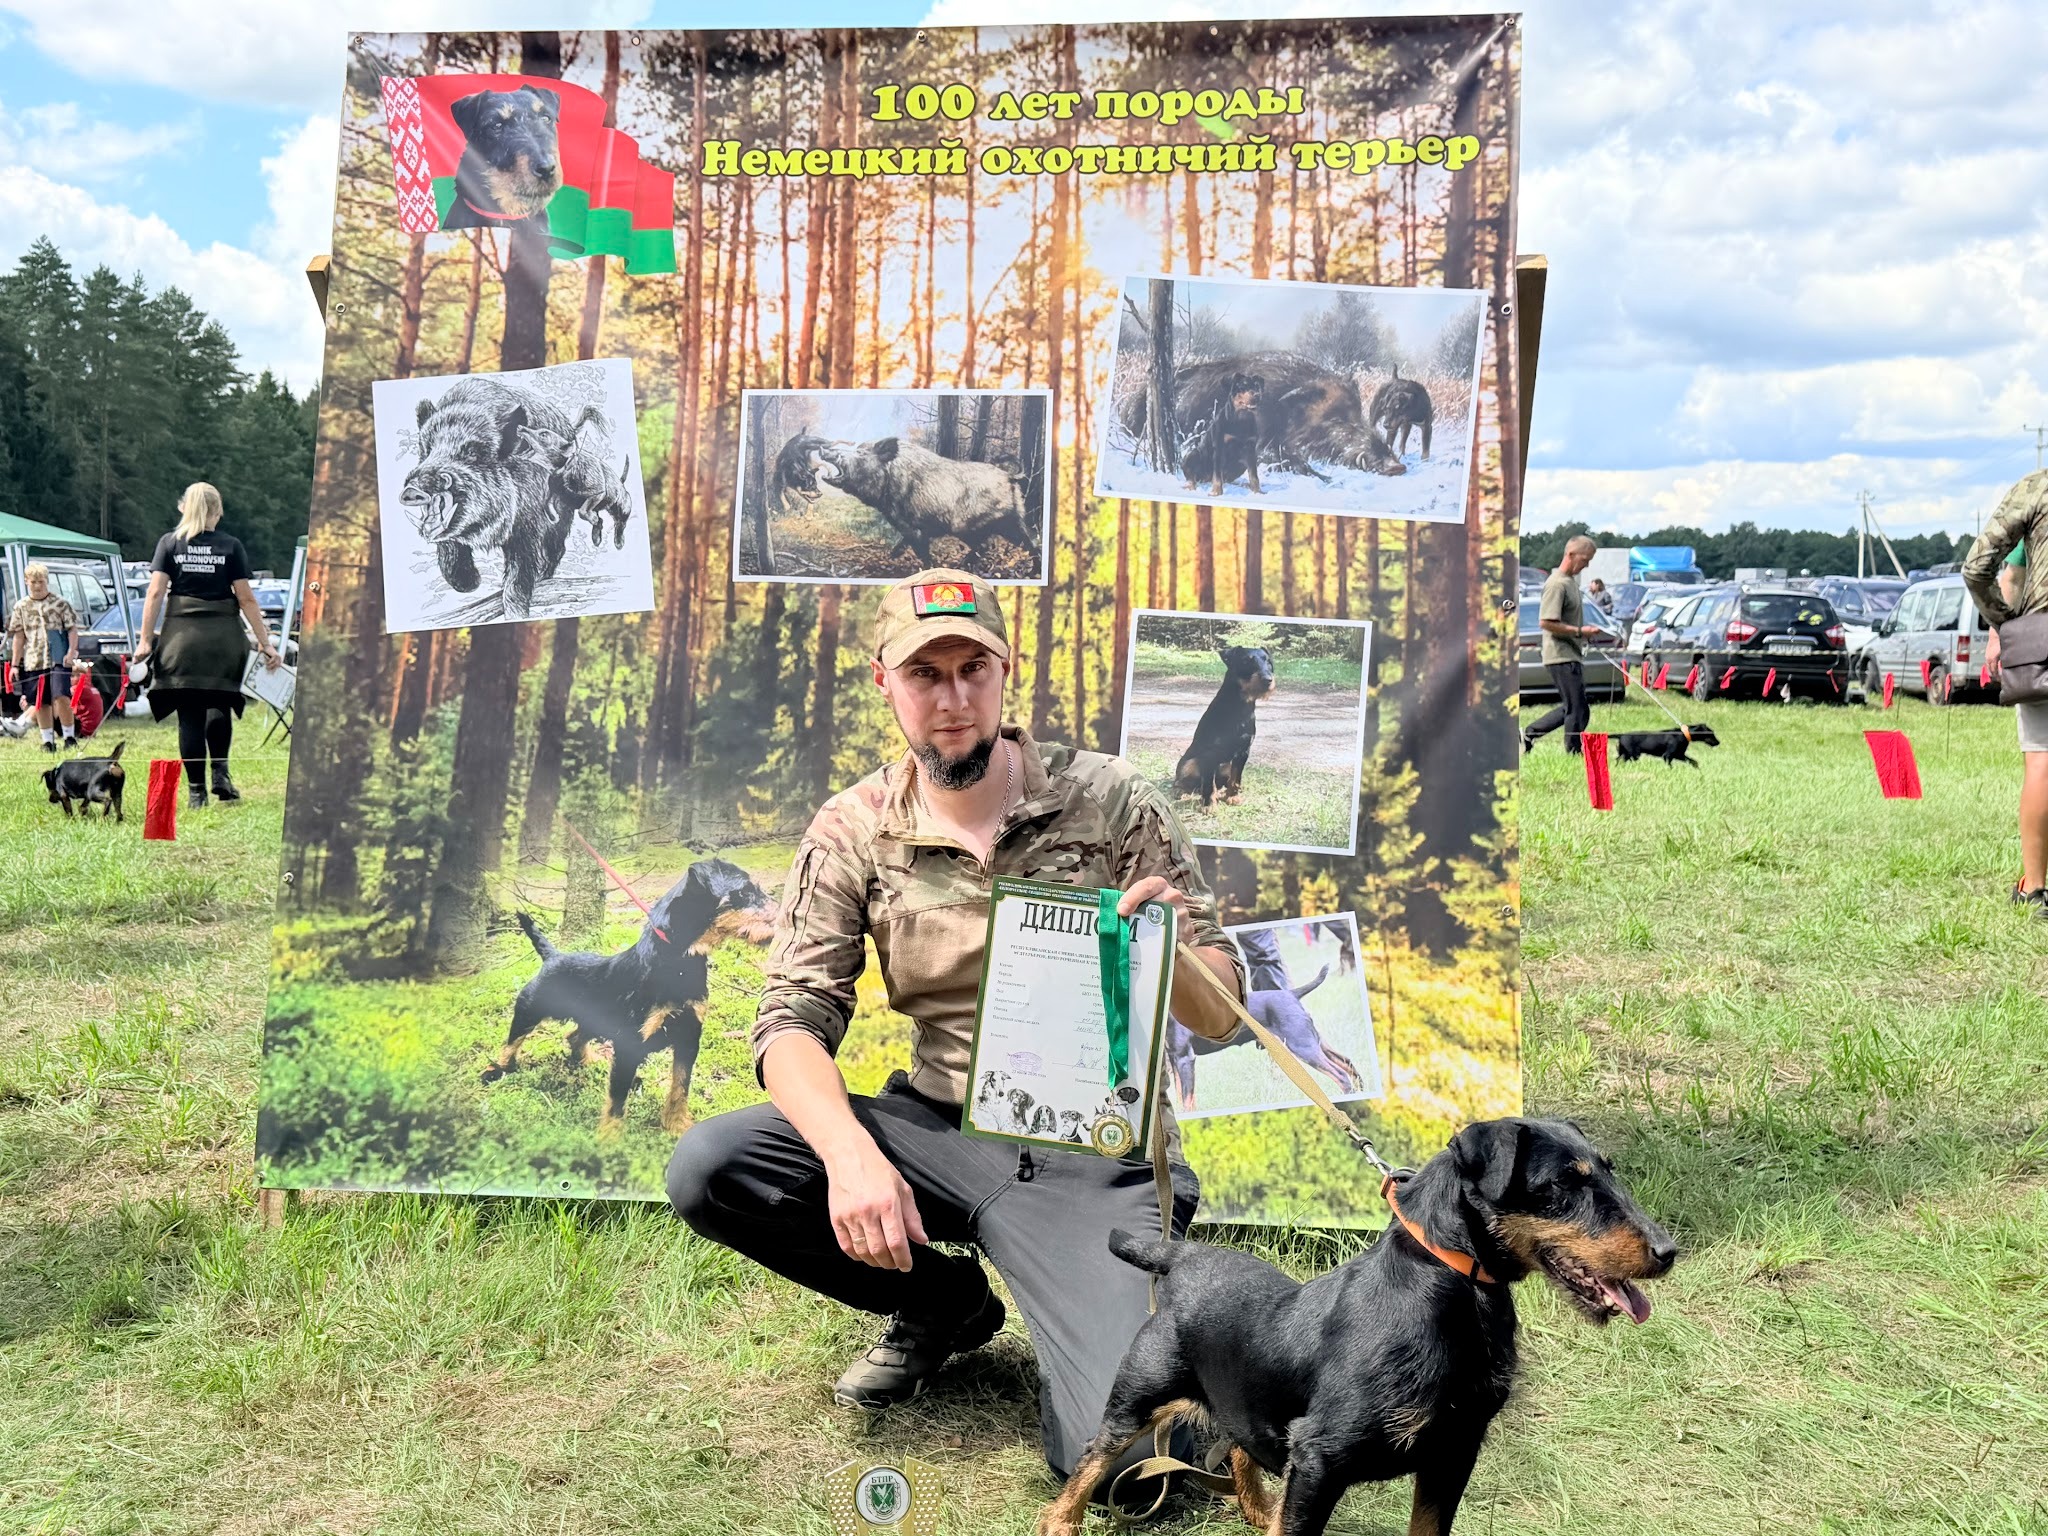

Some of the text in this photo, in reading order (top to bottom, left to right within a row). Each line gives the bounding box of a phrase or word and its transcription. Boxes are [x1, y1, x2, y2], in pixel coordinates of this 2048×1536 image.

[870, 83, 1306, 125] 100 лет породы
[701, 134, 1482, 180] Немецкий охотничий терьер
[173, 554, 226, 565] VOLKONOVSKI
[187, 545, 212, 554] DANIK
[1020, 902, 1140, 942] ДИПЛМ
[871, 1475, 894, 1484] БТПР
